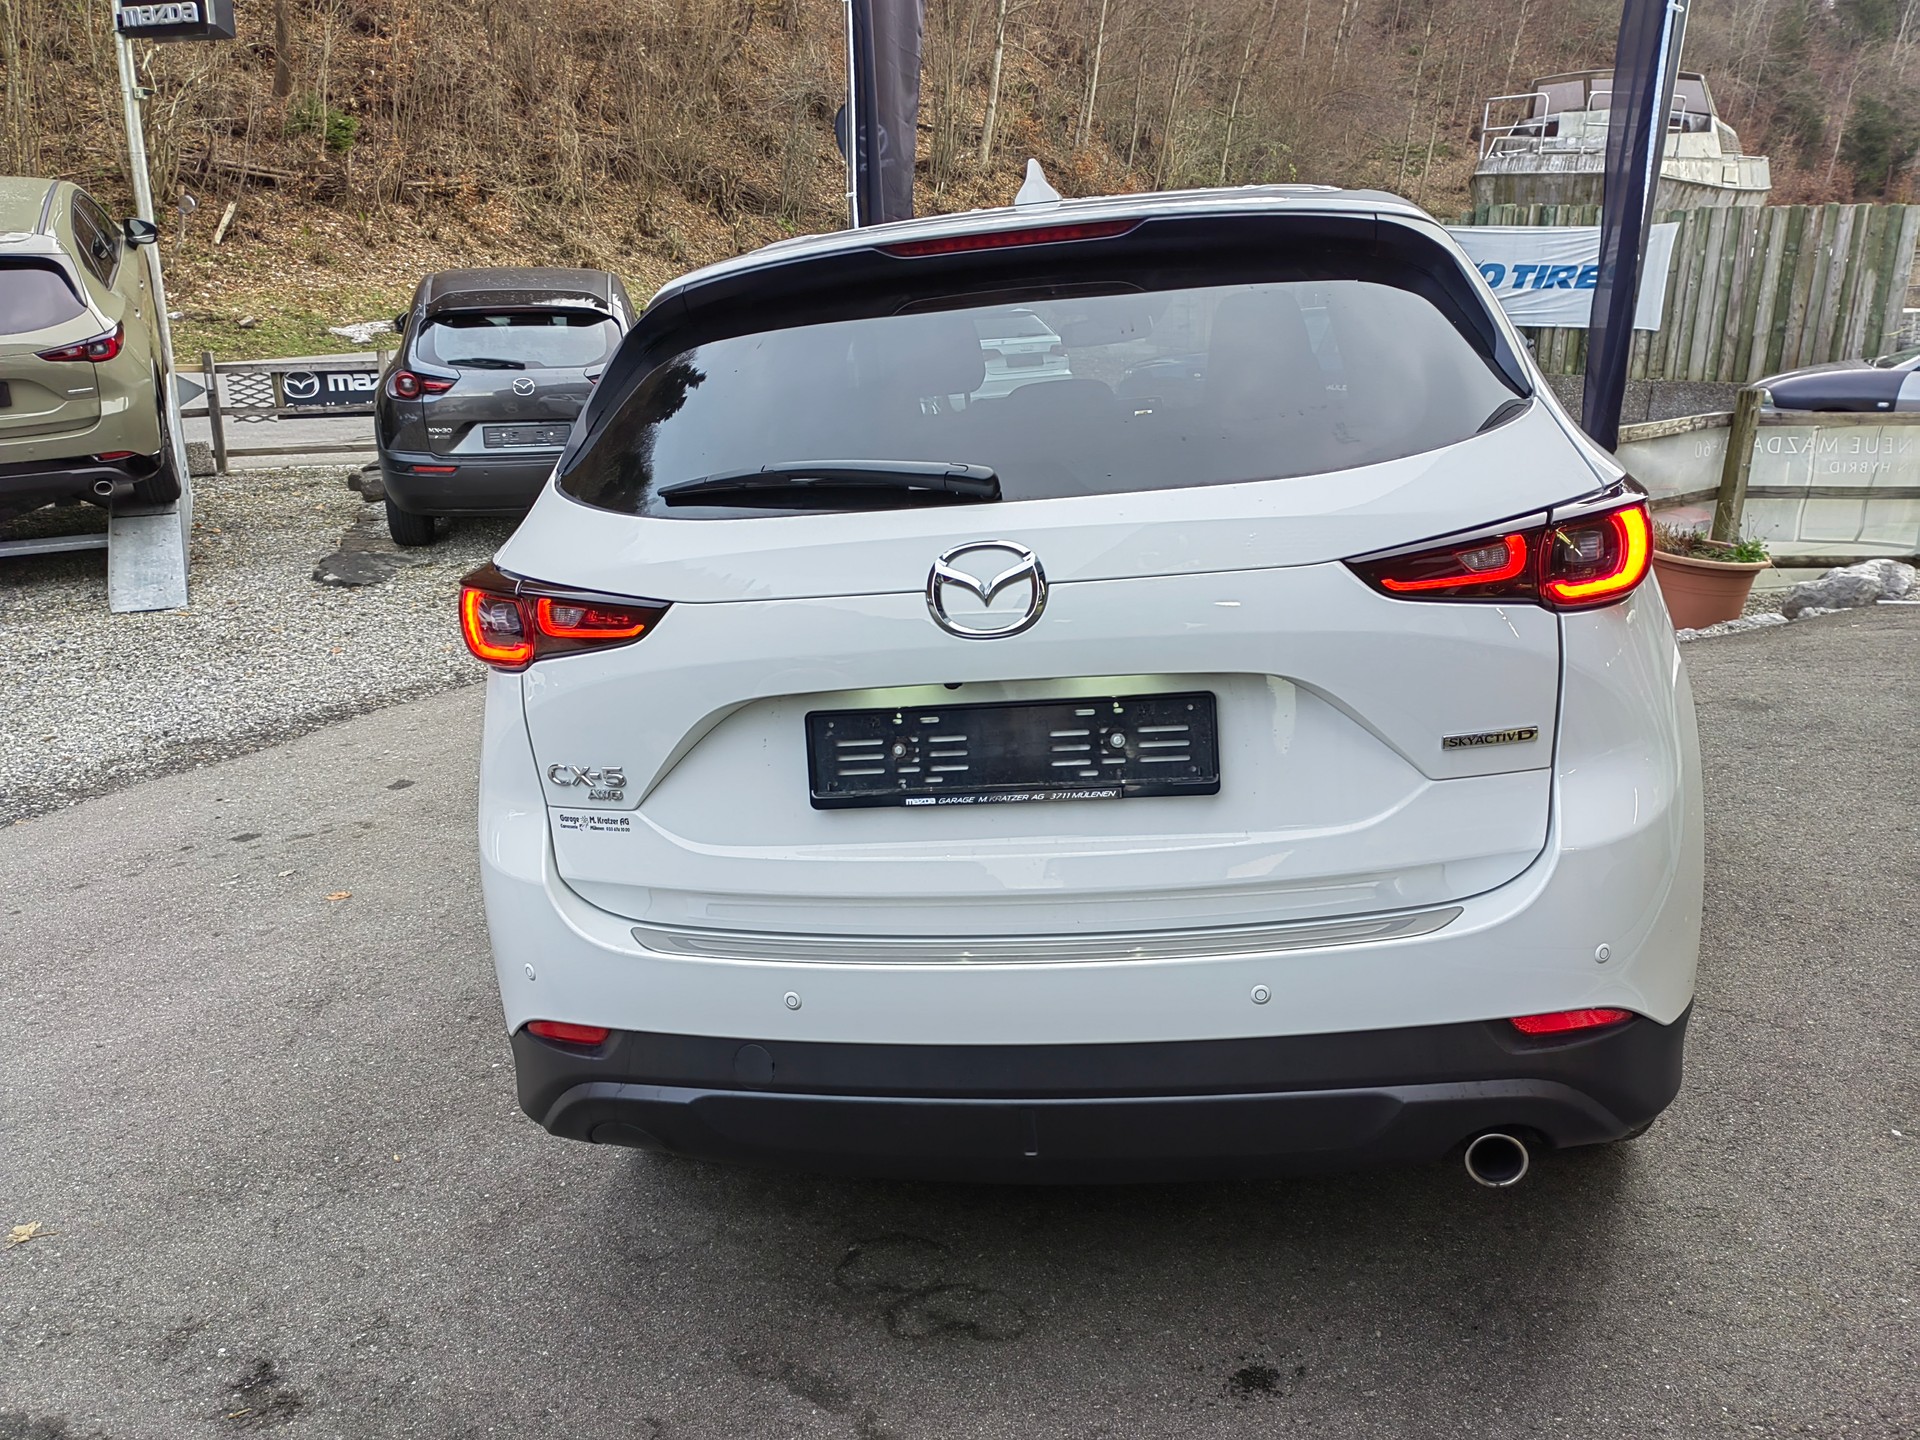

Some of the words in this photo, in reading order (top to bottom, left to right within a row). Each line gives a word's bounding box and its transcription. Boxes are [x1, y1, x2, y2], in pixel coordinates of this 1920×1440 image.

[327, 373, 379, 392] maz
[547, 763, 627, 788] CX-5
[938, 796, 975, 804] GARAGE
[1031, 793, 1045, 801] AG
[1050, 792, 1071, 800] 3711
[1071, 790, 1117, 799] MÜLENEN
[560, 814, 580, 824] Garage
